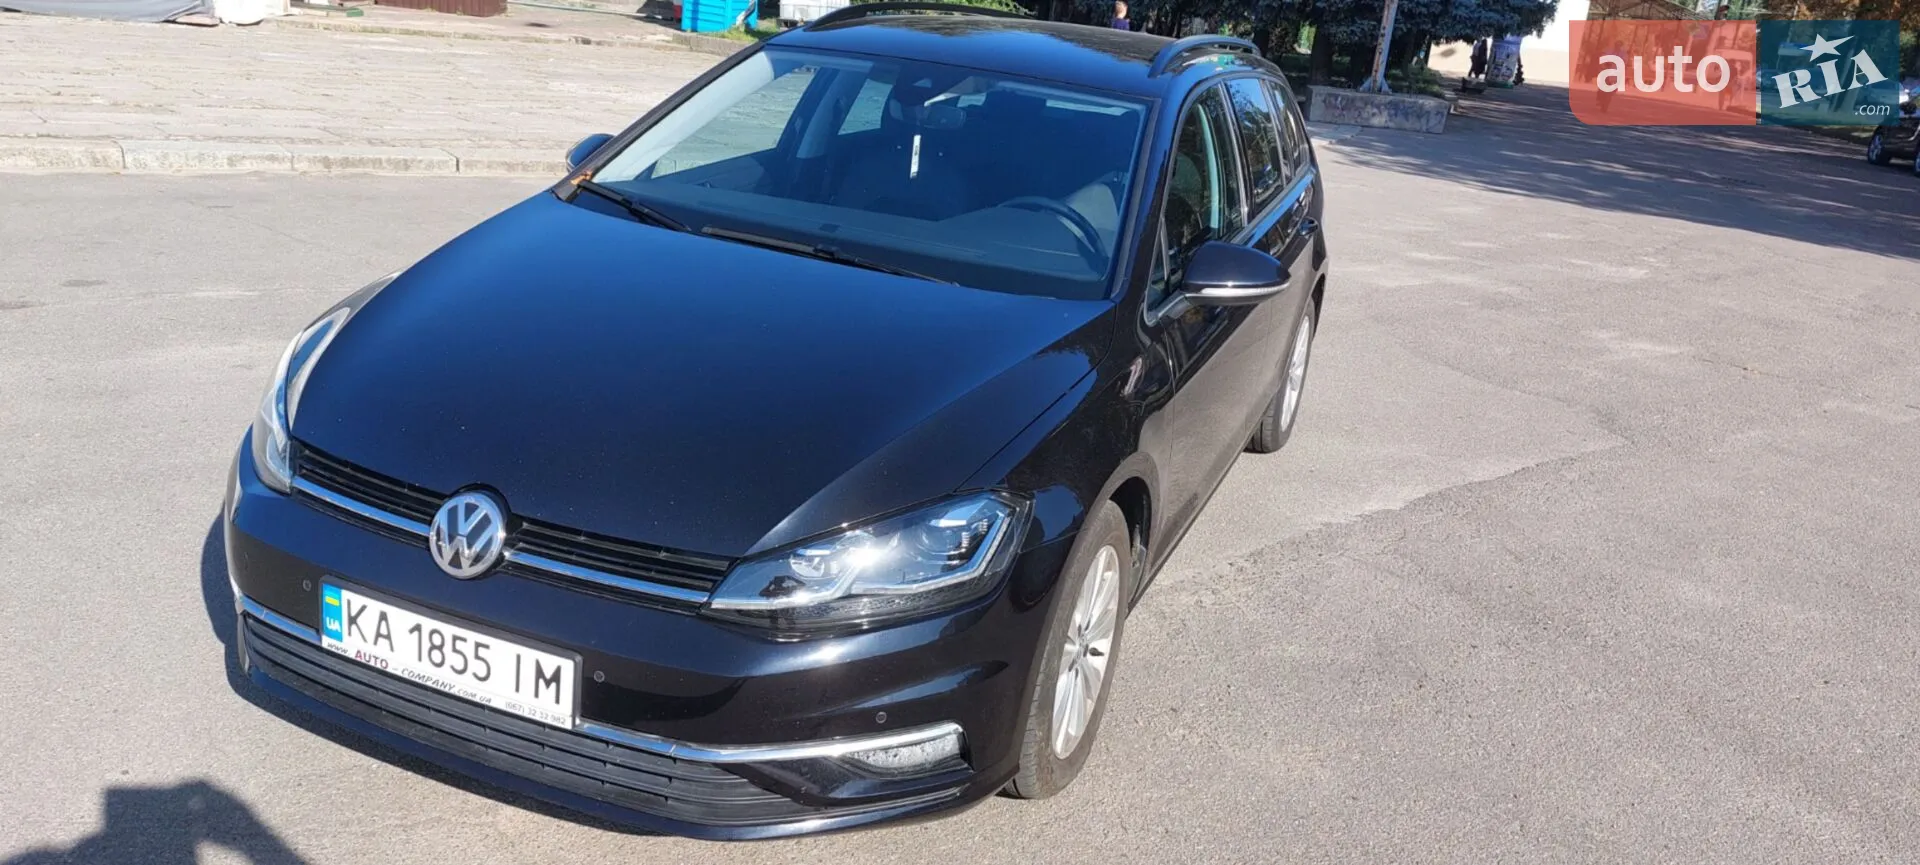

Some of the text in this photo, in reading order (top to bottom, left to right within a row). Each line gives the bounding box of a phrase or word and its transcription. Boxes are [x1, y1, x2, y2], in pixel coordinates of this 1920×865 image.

[326, 616, 341, 632] UA
[347, 598, 562, 705] KA 1855 IM
[355, 650, 389, 670] AUTO
